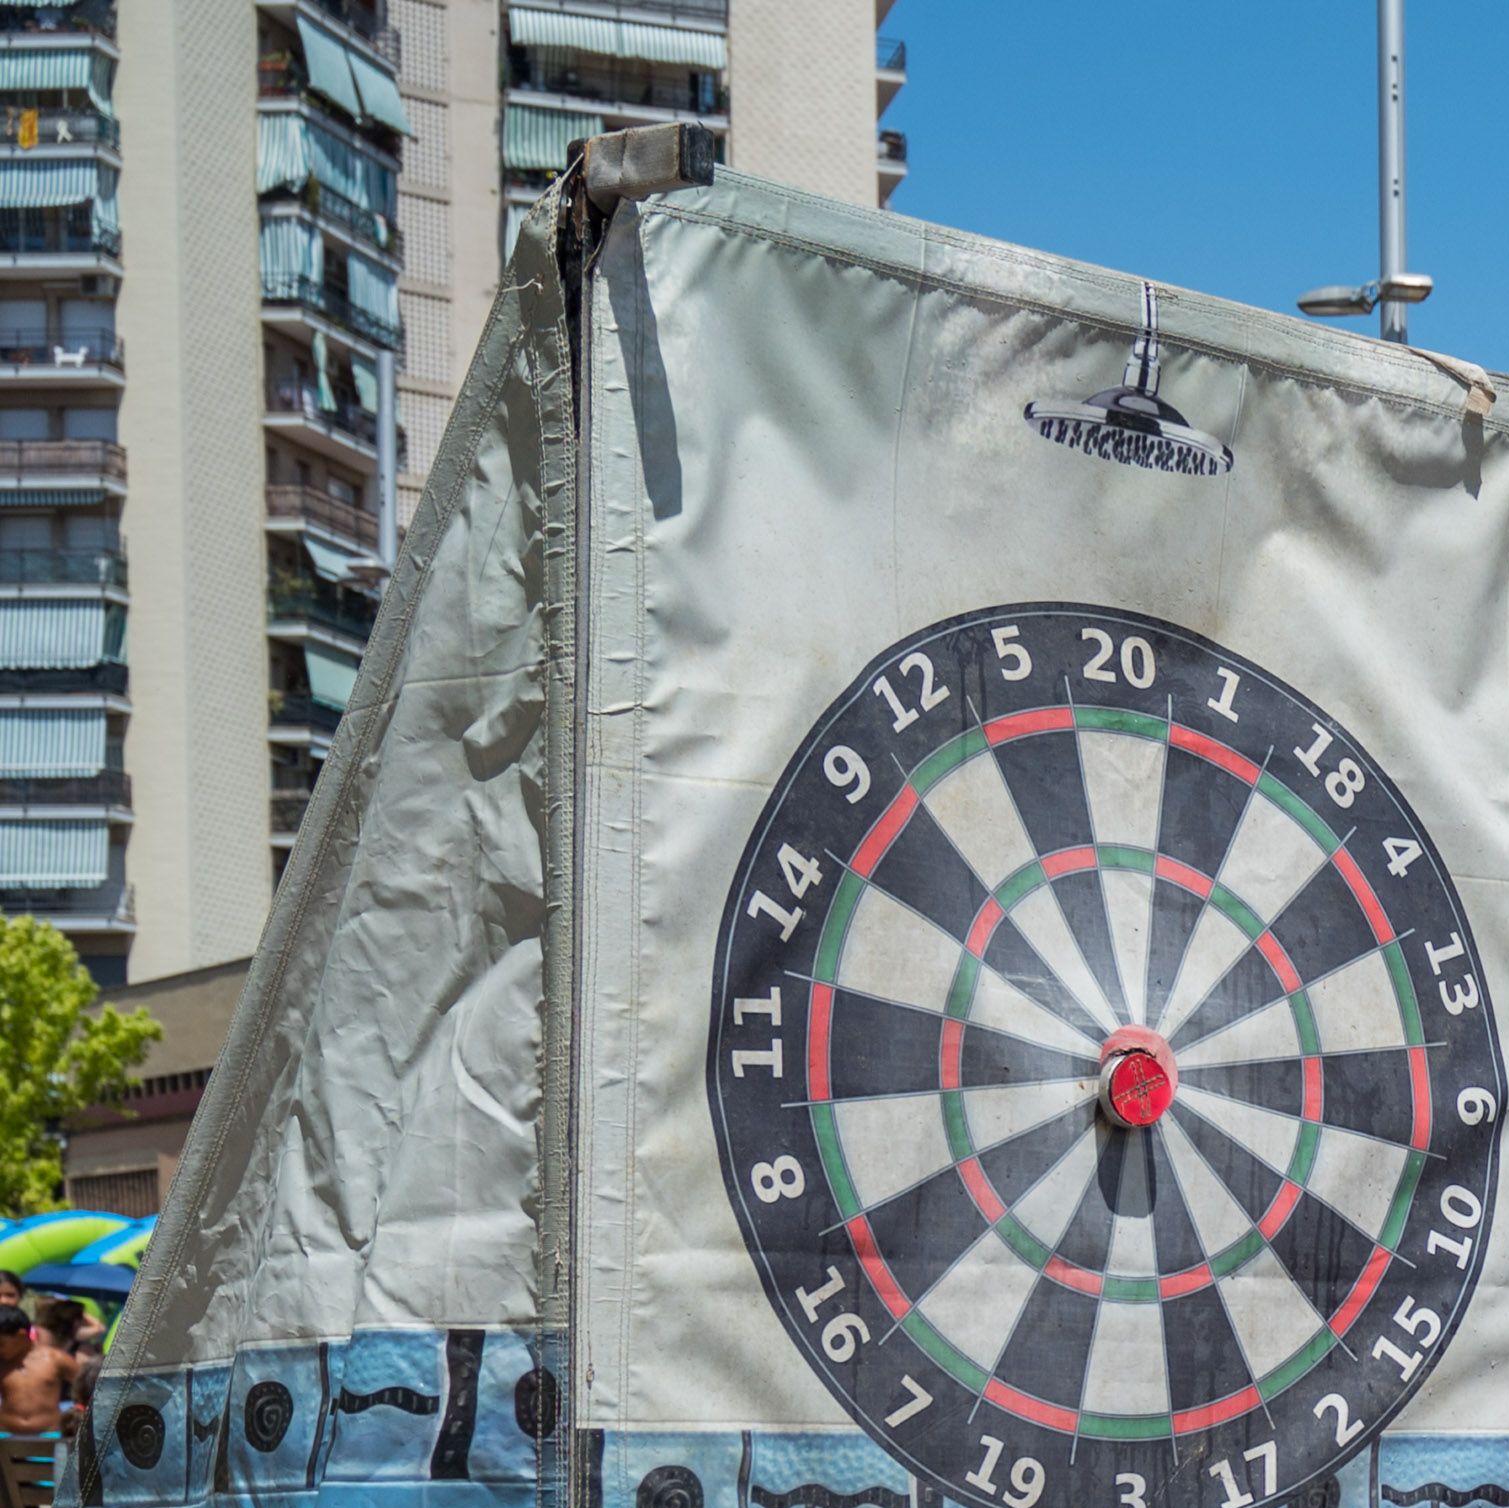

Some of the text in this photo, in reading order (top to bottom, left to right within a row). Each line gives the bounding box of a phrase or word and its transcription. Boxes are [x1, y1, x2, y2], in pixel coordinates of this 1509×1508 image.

[991, 625, 1033, 681] 5
[1082, 628, 1156, 688] 20
[873, 653, 950, 733] 12
[1208, 667, 1241, 722] 1
[824, 746, 870, 803] 9
[1293, 723, 1366, 809] 18
[1383, 837, 1420, 878] 4
[747, 843, 822, 941] 14
[1425, 932, 1478, 1016] 13
[732, 987, 783, 1077] 11
[1457, 1086, 1497, 1126] 6
[751, 1155, 805, 1203] 8
[1427, 1185, 1482, 1269] 10
[796, 1266, 870, 1363] 16
[1373, 1296, 1442, 1381] 15
[885, 1375, 934, 1428] 7
[1313, 1394, 1365, 1446] 2
